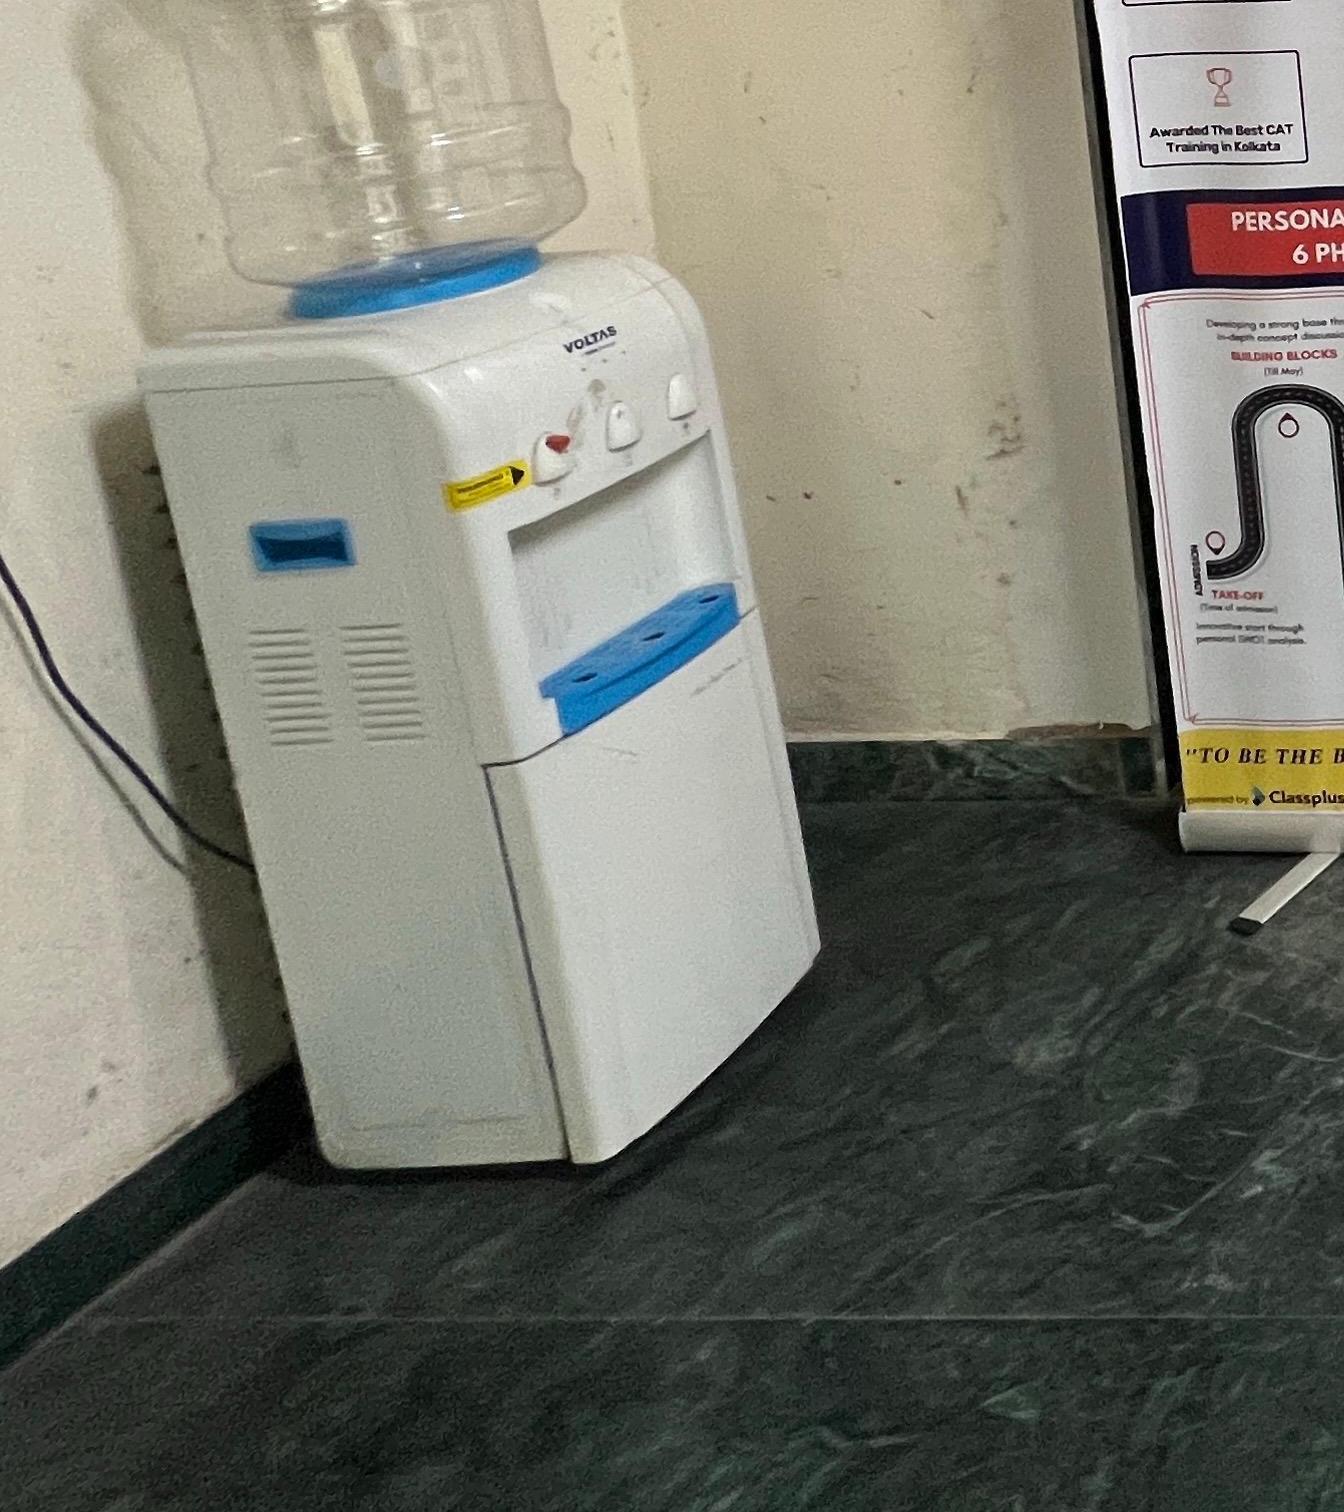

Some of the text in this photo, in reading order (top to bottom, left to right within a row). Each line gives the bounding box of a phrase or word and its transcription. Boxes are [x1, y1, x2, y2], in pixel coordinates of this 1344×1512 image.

[1149, 123, 1294, 138] Awarded The Best CAT
[1166, 140, 1281, 155] Training in Kolkata
[1291, 243, 1310, 265] 6
[1268, 319, 1299, 331] strong
[1302, 319, 1327, 328] base
[563, 325, 617, 354] VOLTAS
[1257, 332, 1298, 343] concept
[1231, 348, 1338, 362] BUILDING BLOCKS
[1211, 589, 1265, 601] TAKE-OFF
[1237, 747, 1267, 764] BE
[1276, 748, 1323, 765] THE
